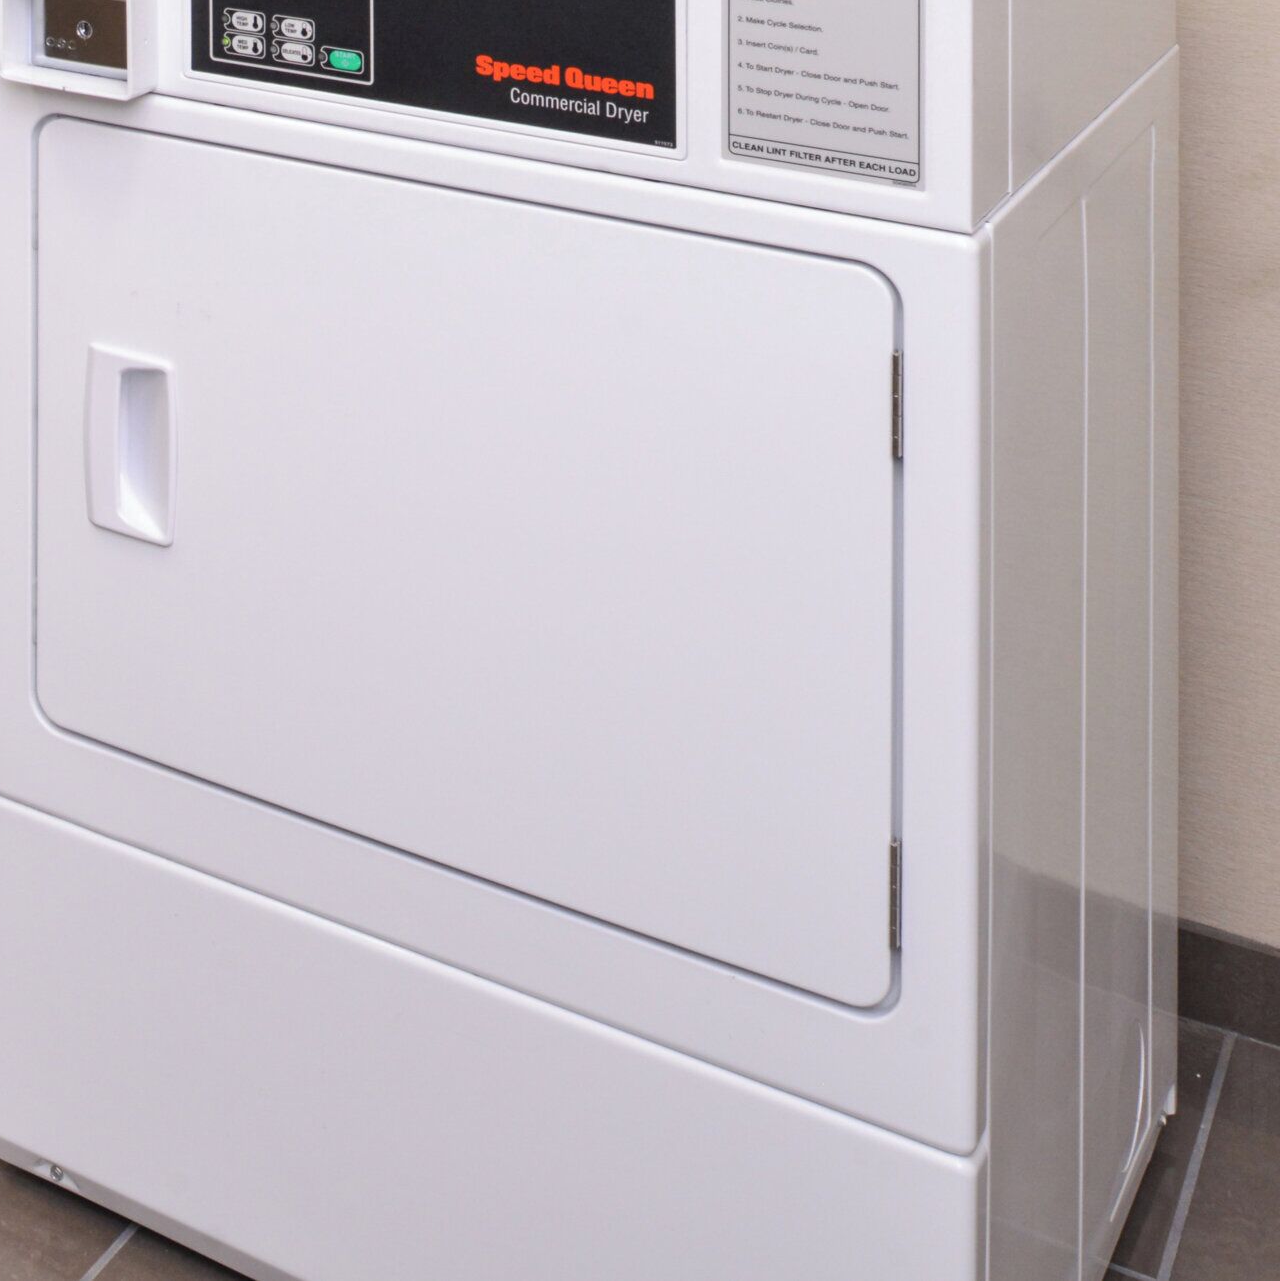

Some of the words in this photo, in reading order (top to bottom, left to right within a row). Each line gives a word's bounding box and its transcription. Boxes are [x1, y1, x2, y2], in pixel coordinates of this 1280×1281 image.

[746, 17, 765, 25] Make
[767, 19, 787, 29] Cycle
[789, 22, 823, 32] Selection.
[475, 54, 560, 86] Speed
[565, 66, 654, 100] Queen
[756, 64, 773, 72] Start
[775, 67, 794, 77] Dryer
[801, 71, 821, 79] Close
[824, 74, 842, 82] Door
[859, 79, 878, 87] Push
[510, 87, 600, 116] Commercial
[606, 102, 649, 124] Dryer
[756, 87, 772, 96] Stop
[774, 90, 793, 99] Dryer
[795, 93, 819, 104] During
[821, 97, 841, 105] Cycle
[848, 101, 869, 110] Open
[756, 110, 781, 120] Restart
[783, 114, 803, 123] Dryer
[810, 119, 830, 127] Close
[833, 122, 850, 130] Door
[852, 125, 866, 133] and
[868, 127, 887, 135] Push
[732, 141, 764, 153] CLEAN
[767, 146, 787, 156] LINT
[790, 150, 822, 163] FILTER
[825, 156, 856, 167] AFTER
[859, 161, 886, 172] EACH
[889, 166, 916, 177] LOAD
